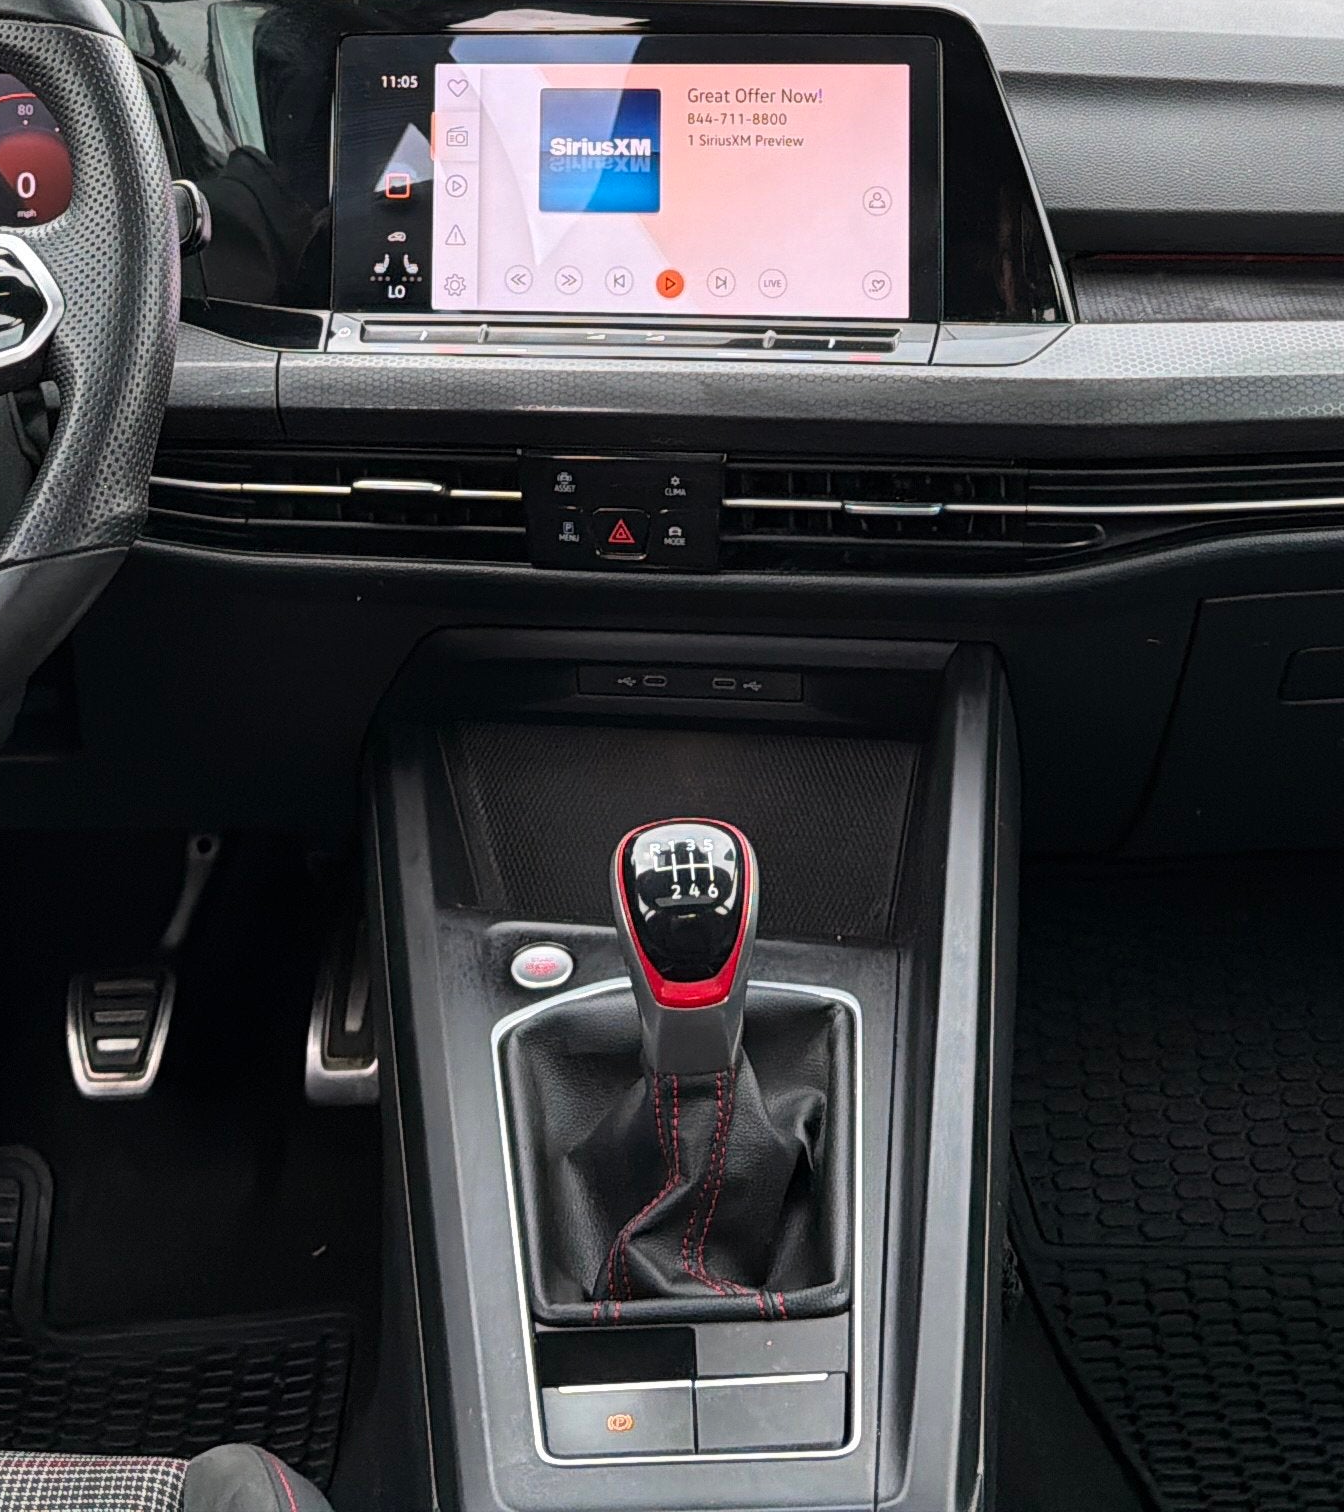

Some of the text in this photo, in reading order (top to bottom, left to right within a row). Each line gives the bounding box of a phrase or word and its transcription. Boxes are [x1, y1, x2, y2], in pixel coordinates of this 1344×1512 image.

[381, 75, 419, 89] 11:05
[687, 87, 824, 105] Great Offer Now!
[17, 104, 34, 116] 80
[687, 111, 788, 127] 844-711-8800
[549, 136, 652, 157] SiriusXM
[688, 134, 805, 148] 1 SiriusXM Preview
[17, 172, 36, 199] 0
[17, 208, 37, 220] mph
[763, 278, 783, 289] LIVE
[388, 284, 406, 299] LO
[664, 488, 687, 497] CLIMA
[559, 534, 579, 543] MENU
[664, 537, 686, 546] MODE
[649, 838, 714, 855] R 1 3 5
[671, 884, 719, 899] 2 4 6
